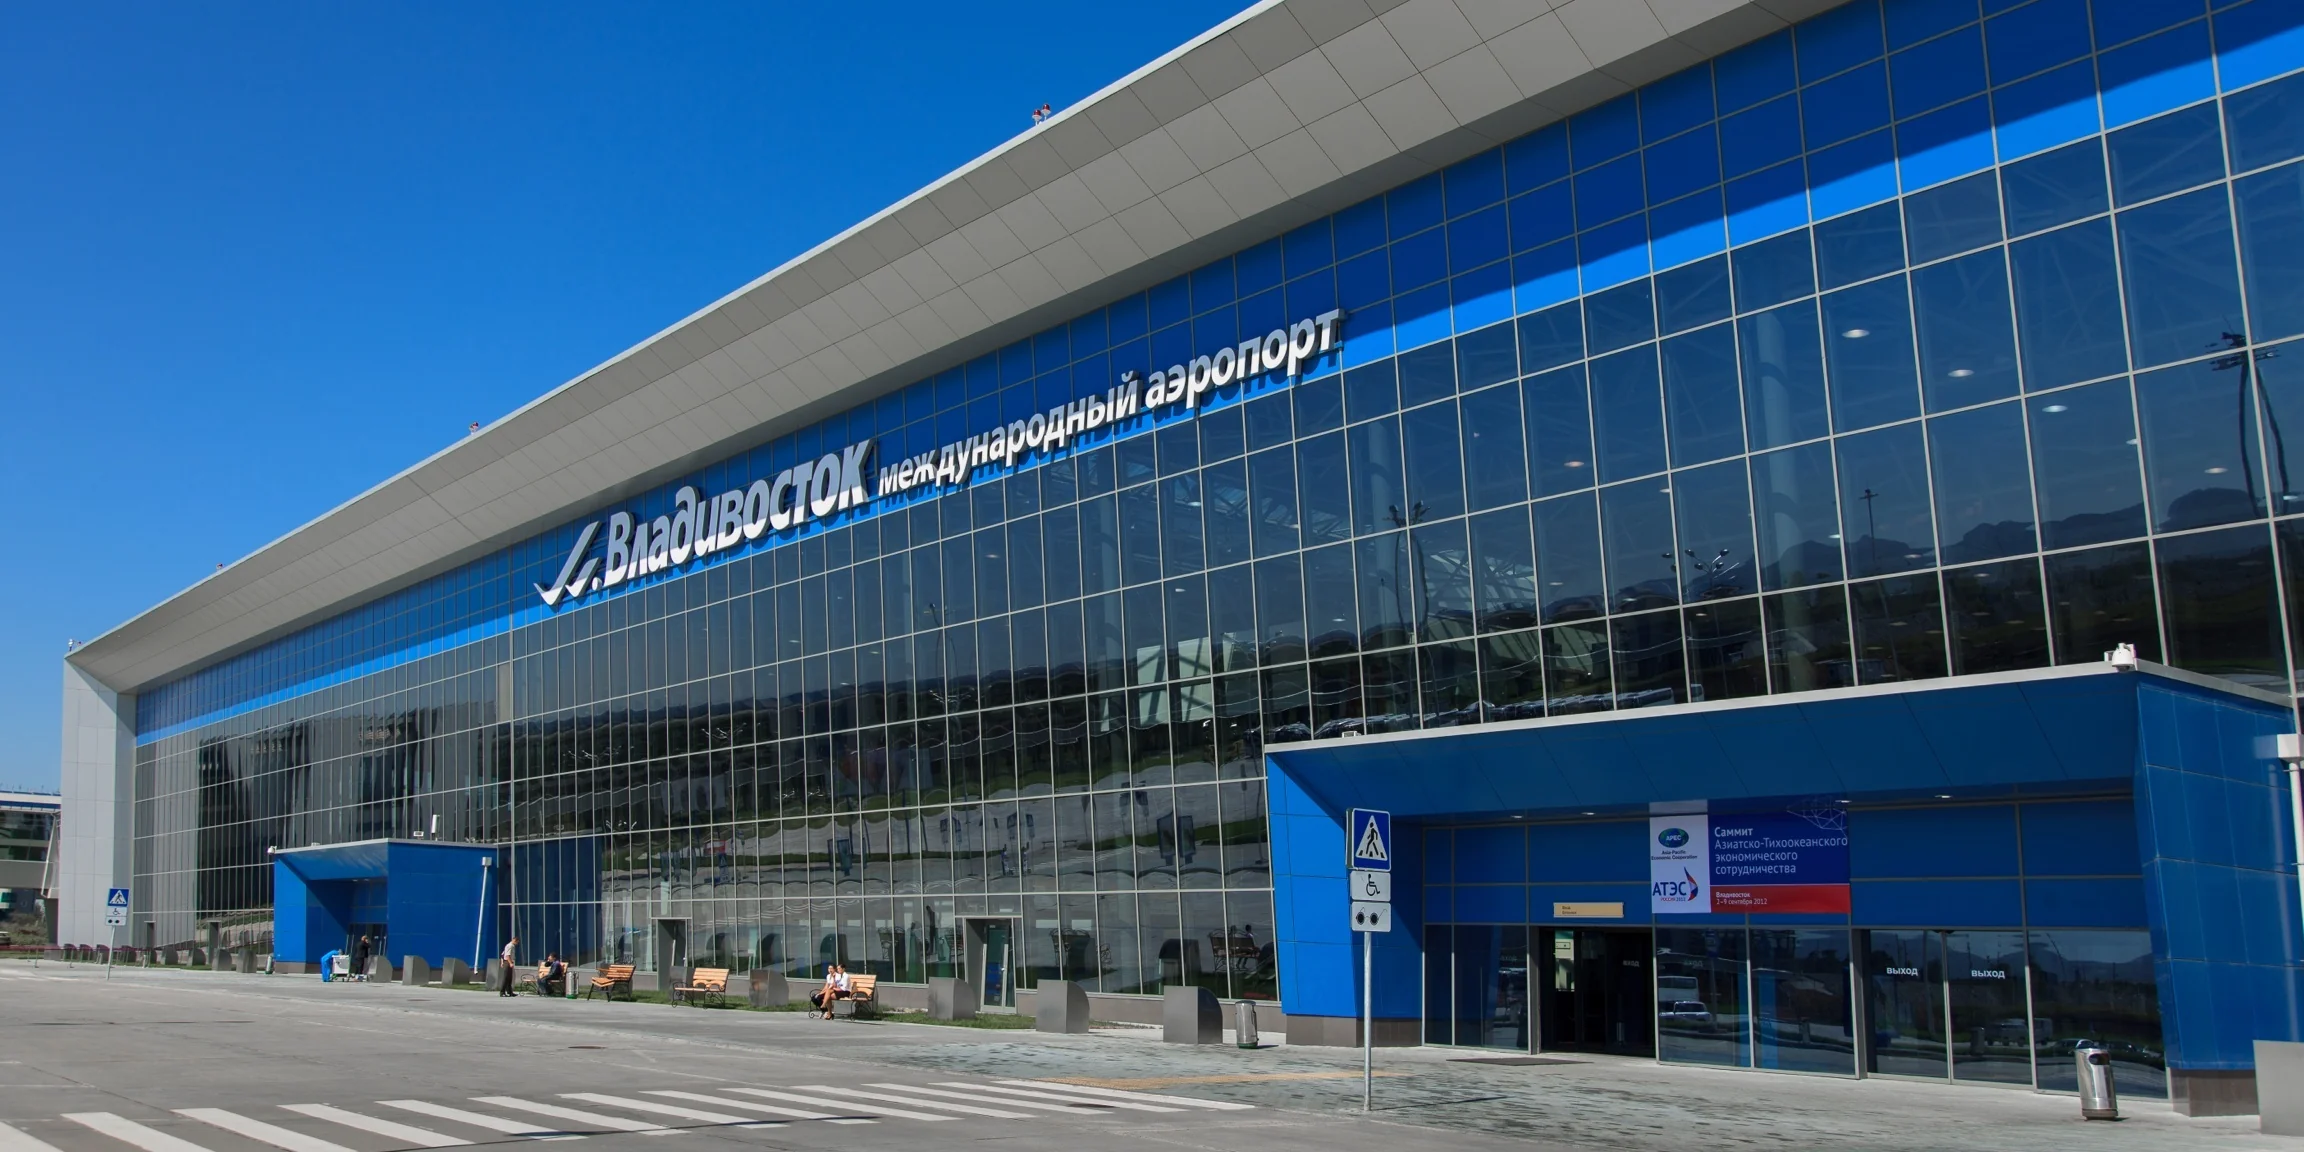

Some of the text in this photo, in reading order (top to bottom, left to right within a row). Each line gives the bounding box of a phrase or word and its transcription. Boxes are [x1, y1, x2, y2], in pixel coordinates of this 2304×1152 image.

[604, 307, 1346, 588] Владивосток международный аэропорт
[1714, 826, 1753, 838] Саммит
[1714, 837, 1848, 850] Азиатско-Тихоокеанского
[1715, 851, 1798, 863] экономического
[1715, 864, 1797, 877] сотрудничества
[1652, 881, 1687, 896] АТЭС
[1728, 898, 1753, 906] сентября
[1753, 897, 1768, 905] 2012
[1886, 966, 1919, 977] выход
[1971, 969, 2006, 980] выход
